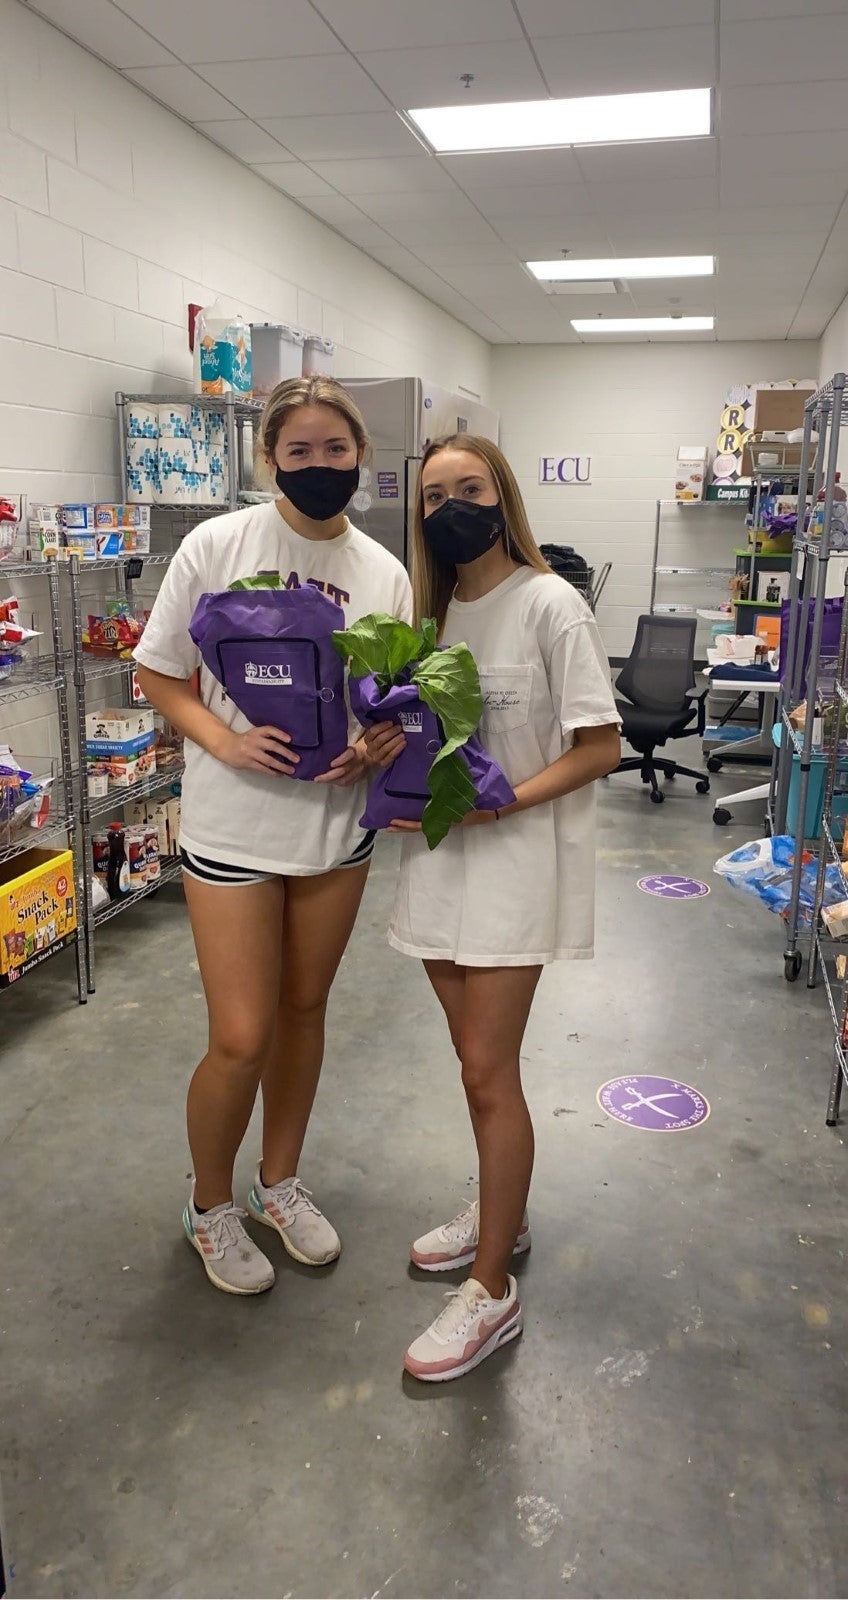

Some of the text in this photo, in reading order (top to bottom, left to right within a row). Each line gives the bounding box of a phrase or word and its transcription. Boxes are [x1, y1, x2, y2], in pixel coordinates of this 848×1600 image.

[728, 410, 740, 426] R
[723, 434, 735, 451] R
[542, 457, 592, 482] ECU
[717, 488, 739, 500] Campus
[257, 570, 350, 606] AT
[258, 664, 291, 678] ECU
[407, 712, 423, 725] ECU
[57, 878, 66, 891] 42
[17, 891, 49, 924] Snack
[35, 899, 59, 925] Pack
[22, 941, 64, 976] Jumbo Snack Pack
